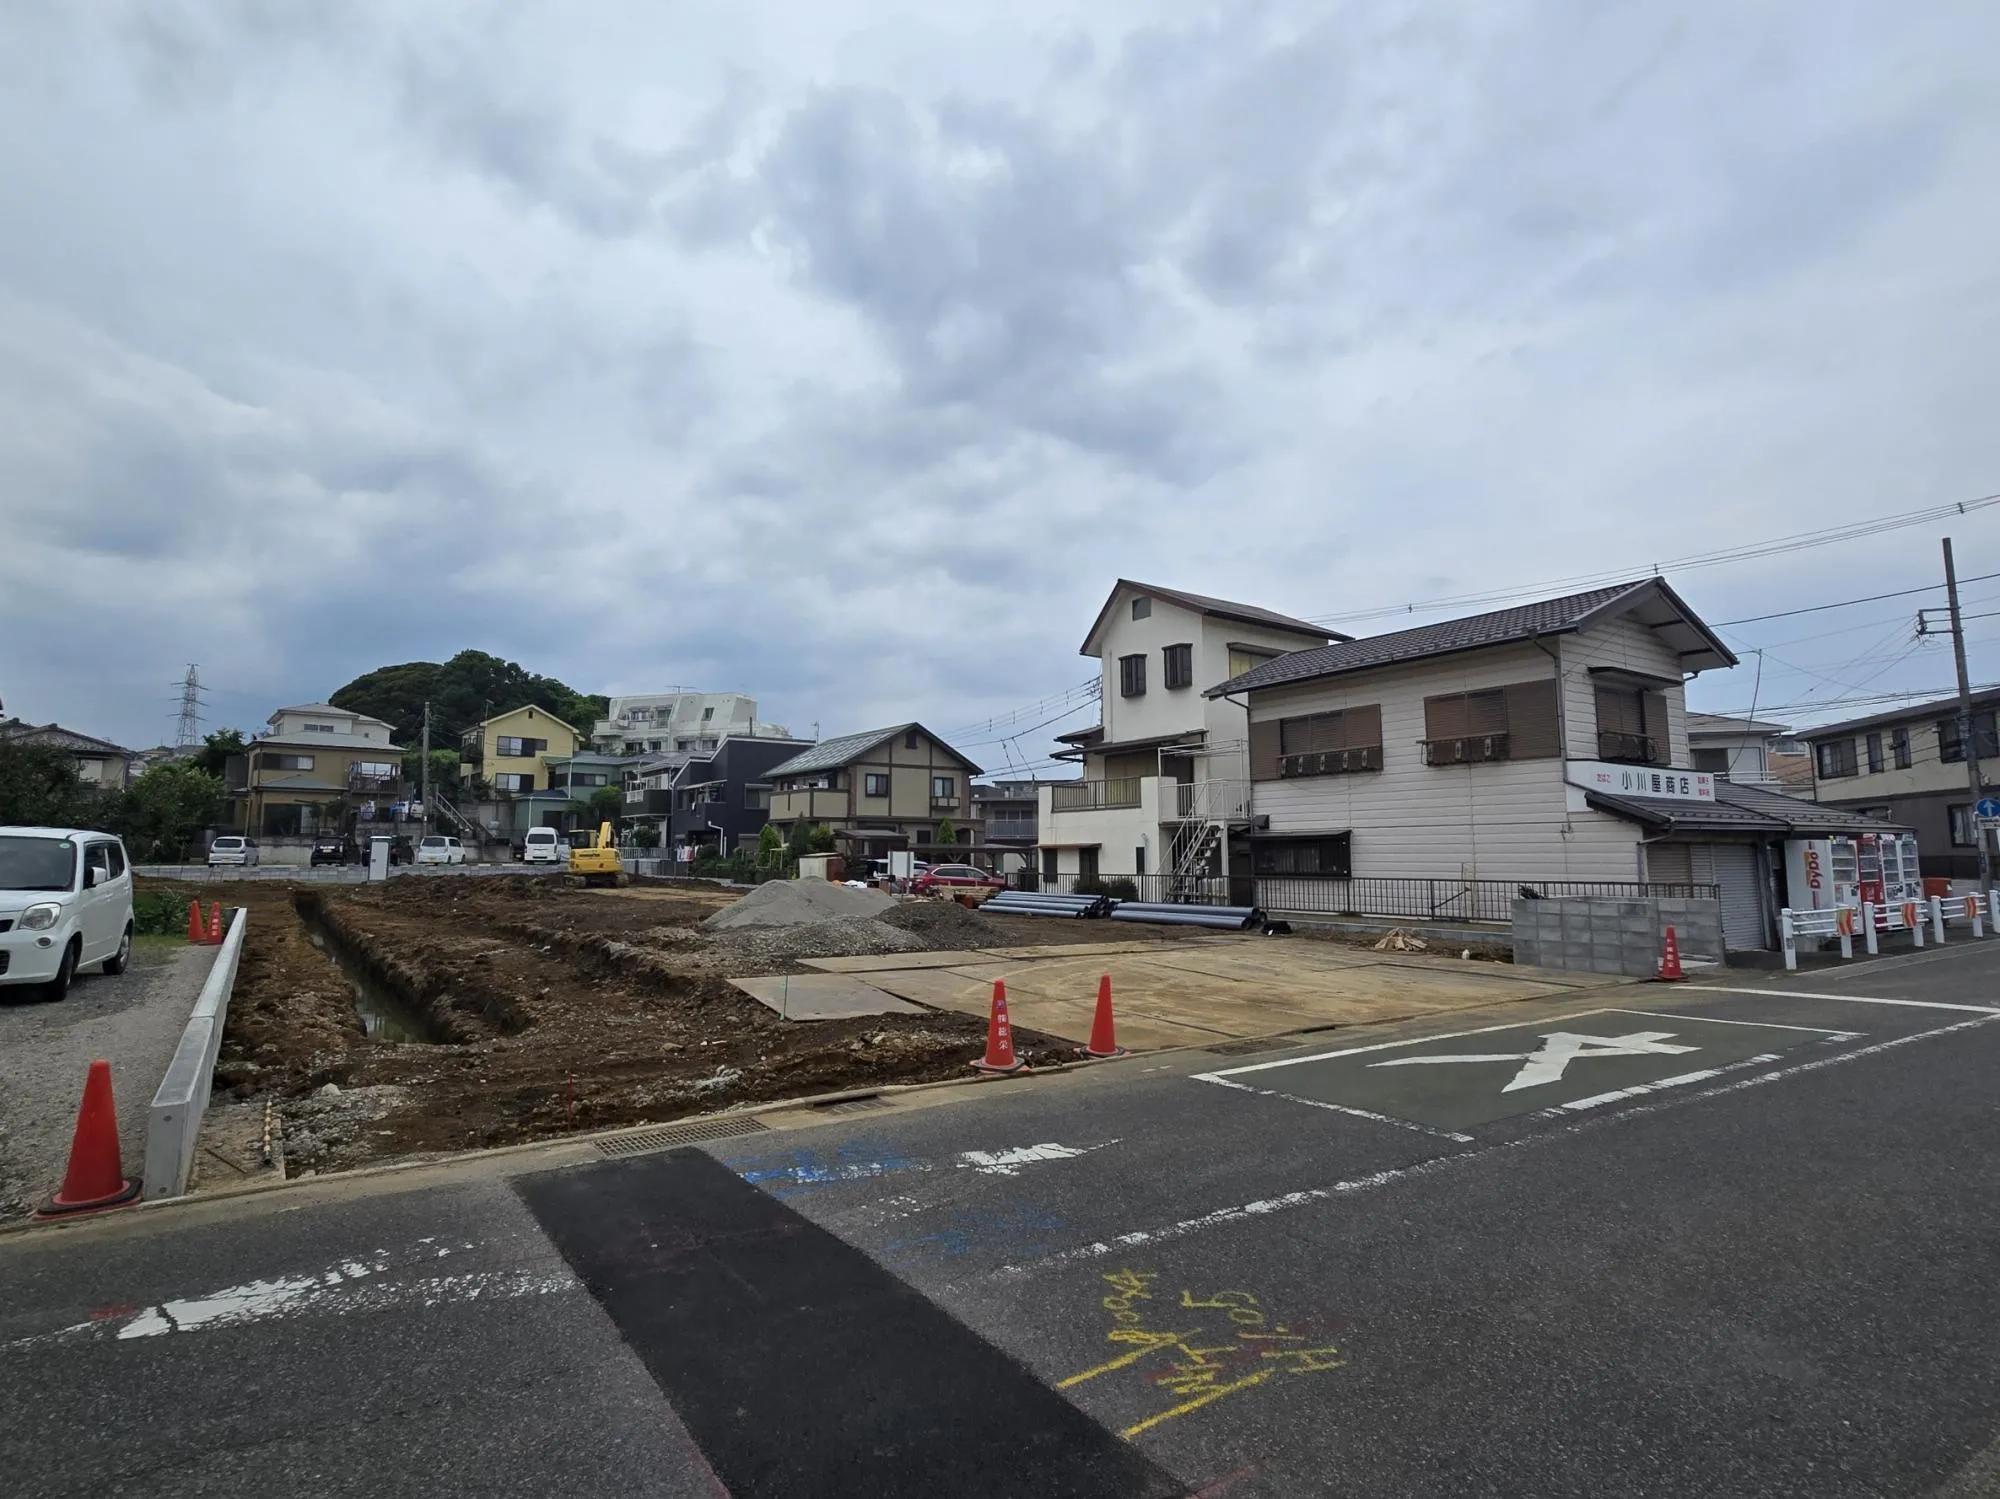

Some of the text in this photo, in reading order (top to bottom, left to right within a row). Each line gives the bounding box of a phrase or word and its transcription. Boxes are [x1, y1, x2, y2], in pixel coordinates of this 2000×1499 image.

[1621, 770, 1690, 795] 小川屋商店
